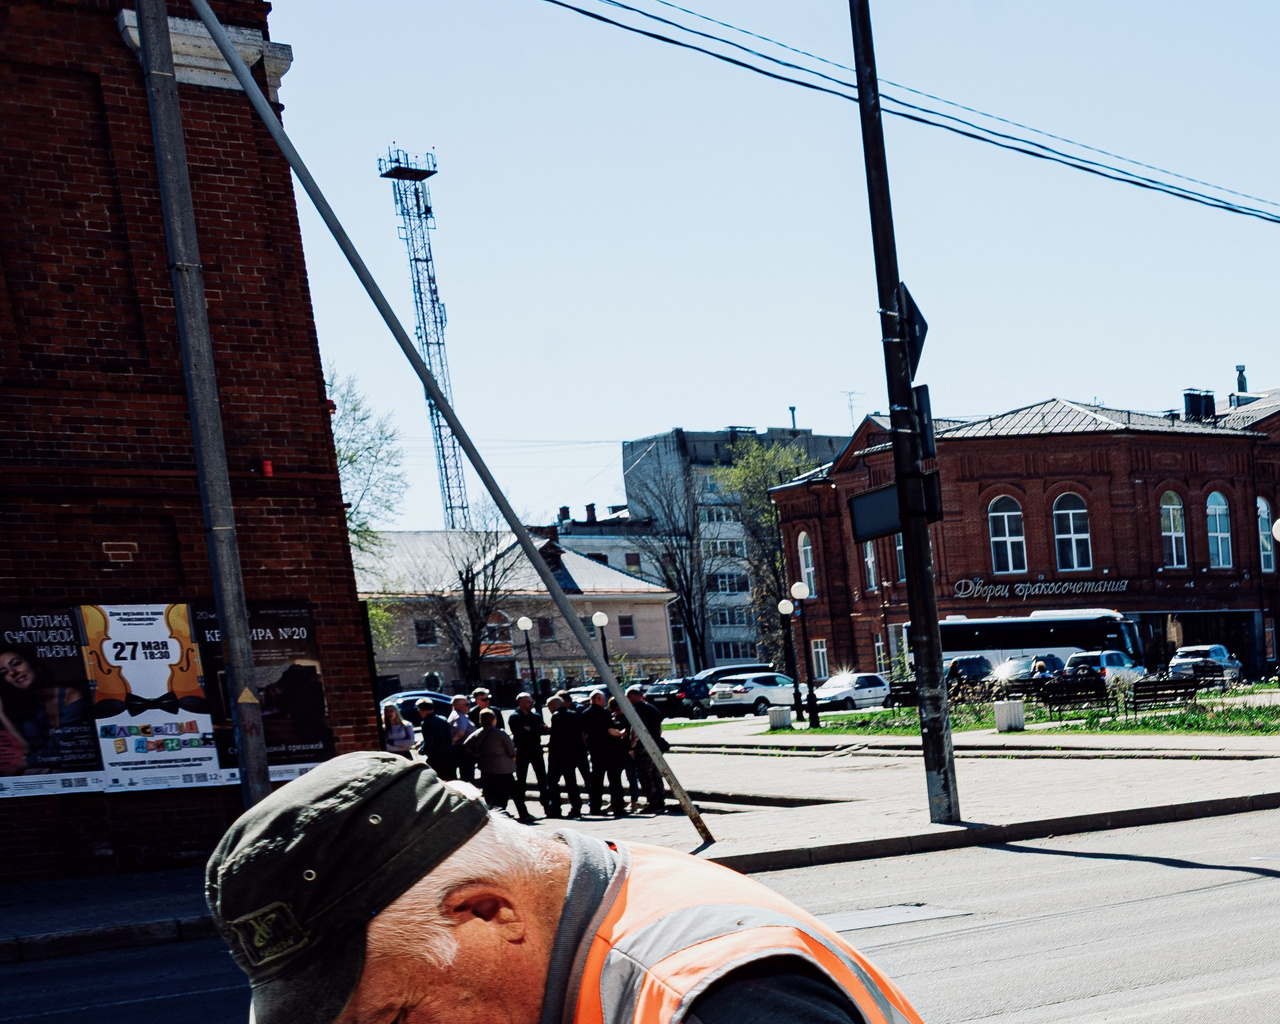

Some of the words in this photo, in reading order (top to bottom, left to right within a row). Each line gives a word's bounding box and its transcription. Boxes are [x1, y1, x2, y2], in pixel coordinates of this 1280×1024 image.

[954, 578, 1010, 602] Дворец
[1014, 579, 1129, 601] бракосочетания
[20, 614, 73, 628] ПОЭТИКА
[3, 627, 75, 644] СЧАСТЛИВОЙ
[278, 626, 308, 640] №20
[35, 644, 78, 658] ЖИЗНИ
[112, 641, 139, 661] 27
[142, 650, 171, 660] 18:30
